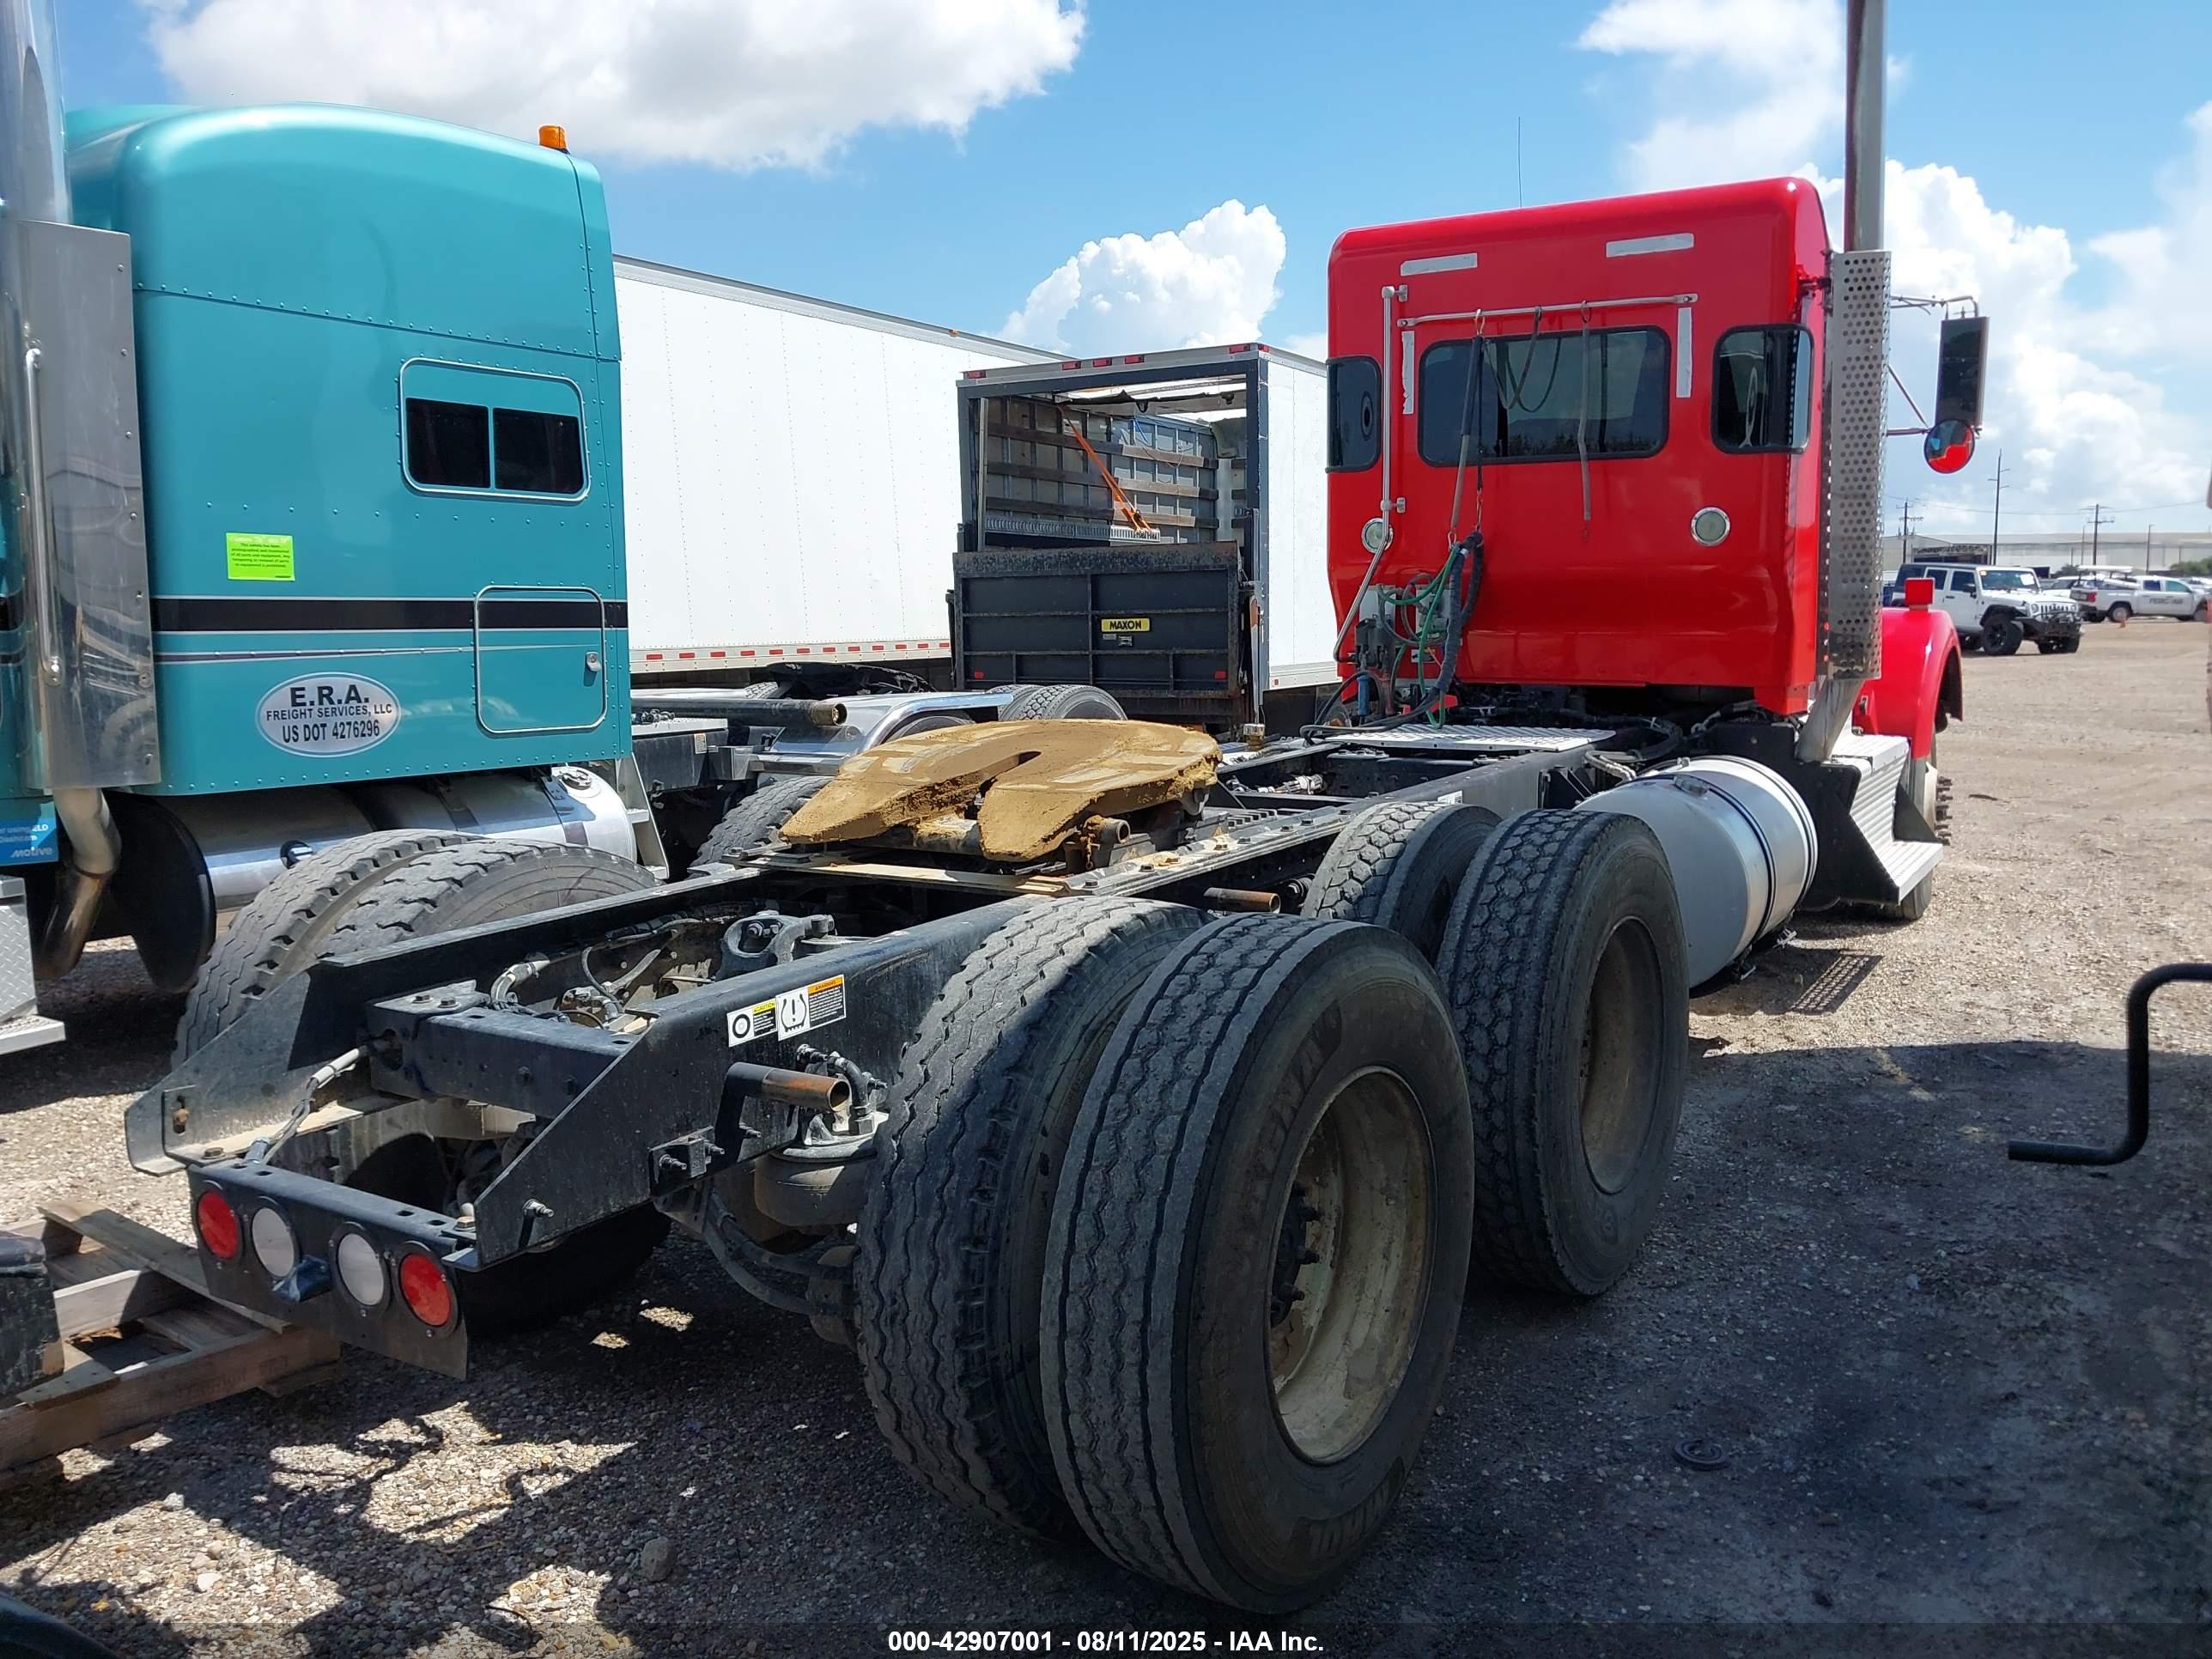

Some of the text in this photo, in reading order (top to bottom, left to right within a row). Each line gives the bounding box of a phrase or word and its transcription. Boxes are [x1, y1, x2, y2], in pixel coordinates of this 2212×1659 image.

[1109, 619, 1142, 630] MAXON
[289, 684, 370, 708] E.R.A.
[266, 703, 392, 721] FREIGHT SERVICES, LLC
[282, 720, 380, 744] US DOT 4276296
